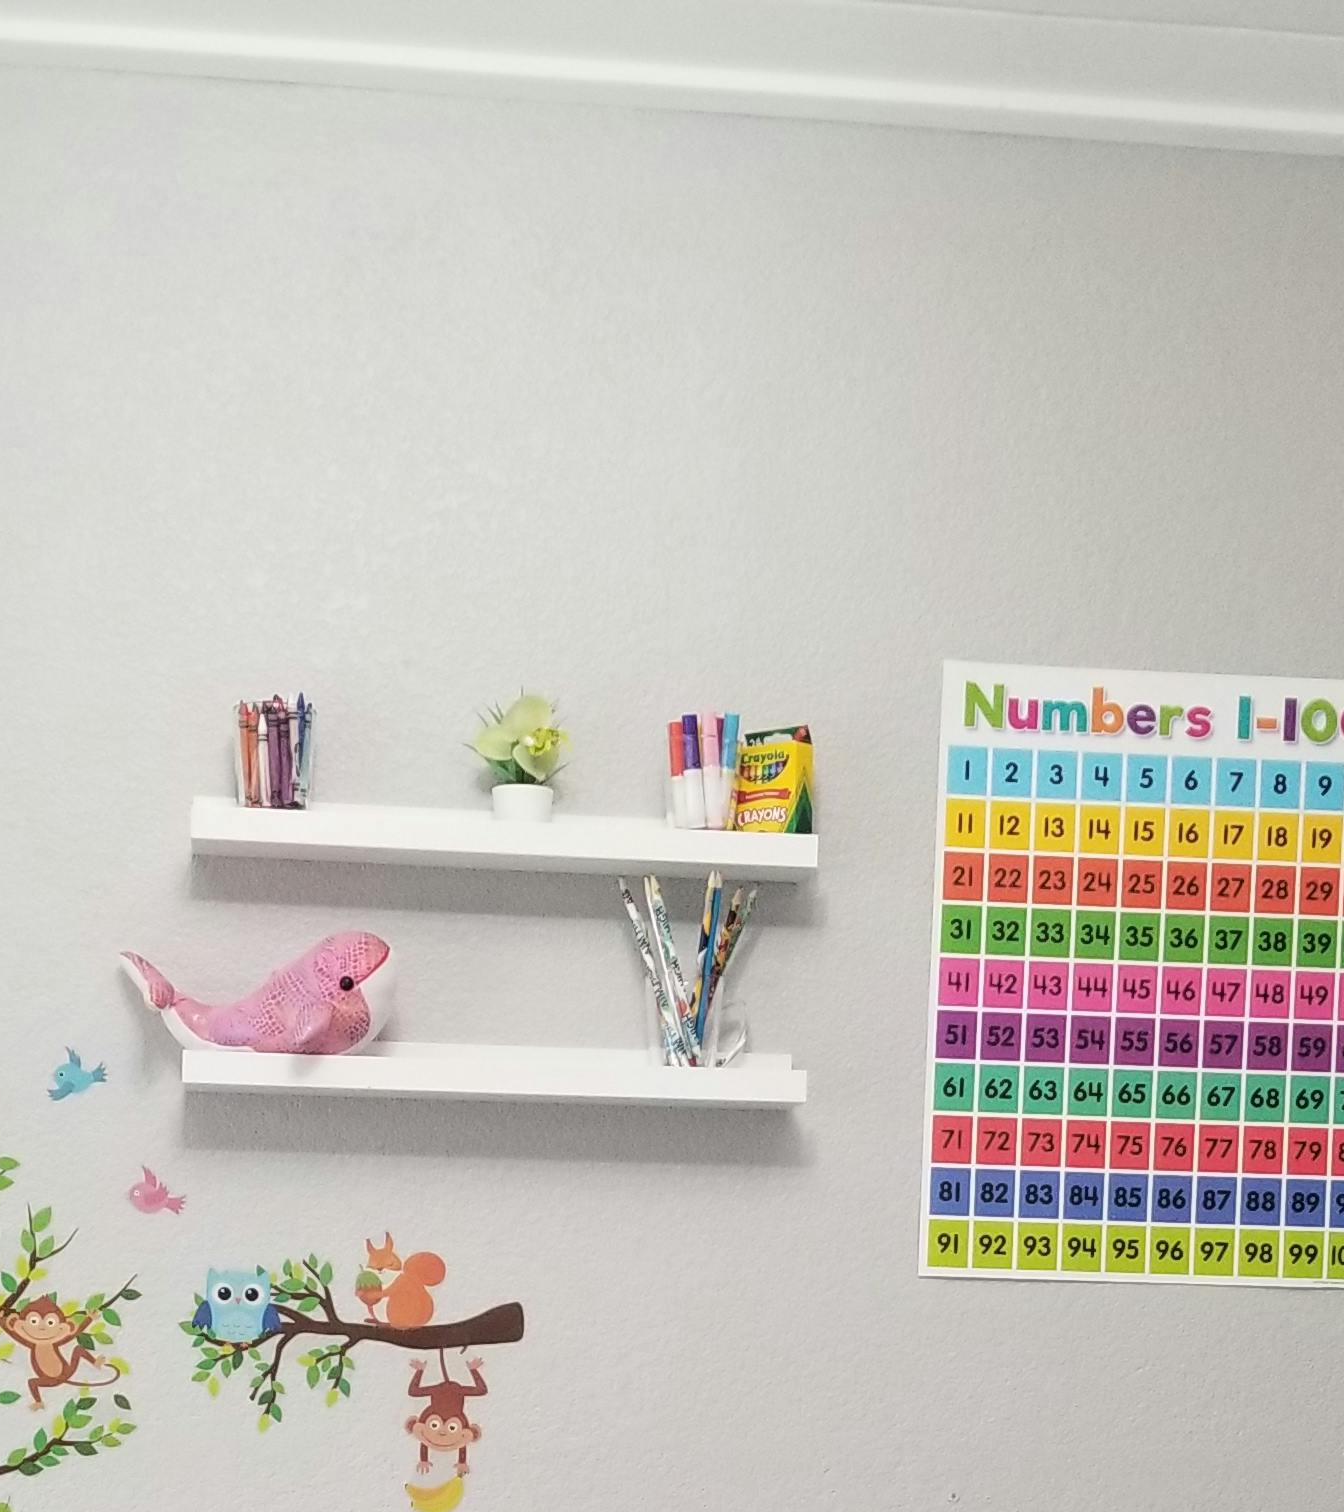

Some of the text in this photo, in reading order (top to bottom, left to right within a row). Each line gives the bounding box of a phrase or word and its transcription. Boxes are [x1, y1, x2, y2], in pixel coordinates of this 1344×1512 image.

[962, 680, 1213, 740] Numbers
[741, 750, 785, 764] Crayola
[964, 759, 970, 781] 1
[1004, 761, 1019, 783] 2
[1049, 764, 1064, 785] 3
[1094, 766, 1110, 788] 4
[1139, 767, 1154, 789] 5
[1184, 769, 1199, 791] 6
[1229, 771, 1244, 793] 7
[1273, 773, 1287, 795] 8
[1318, 775, 1333, 797] 9
[737, 807, 786, 826] CRAYONS
[950, 918, 972, 940] 31
[991, 920, 1020, 942] 32
[1035, 921, 1065, 944] 33
[1080, 923, 1111, 946] 34
[1125, 925, 1154, 948] 35
[1169, 927, 1199, 949] 36
[1214, 929, 1243, 951] 37
[1257, 930, 1287, 953] 38
[1302, 932, 1332, 954] 39
[942, 1076, 965, 1098] 61
[984, 1078, 1013, 1100] 62
[1028, 1079, 1058, 1101] 63
[1073, 1081, 1104, 1103] 64
[1118, 1082, 1146, 1104] 65
[1161, 1084, 1191, 1106] 66
[1206, 1085, 1236, 1107] 67
[1250, 1087, 1280, 1109] 68
[1295, 1088, 1325, 1110] 69
[937, 1232, 959, 1254] 91
[979, 1234, 1007, 1256] 92
[1023, 1235, 1051, 1257] 93
[1067, 1236, 1097, 1258] 94
[1112, 1238, 1140, 1260] 95
[1155, 1239, 1184, 1261] 96
[1200, 1241, 1229, 1262] 97
[1244, 1242, 1273, 1264] 98
[1288, 1243, 1319, 1265] 99
